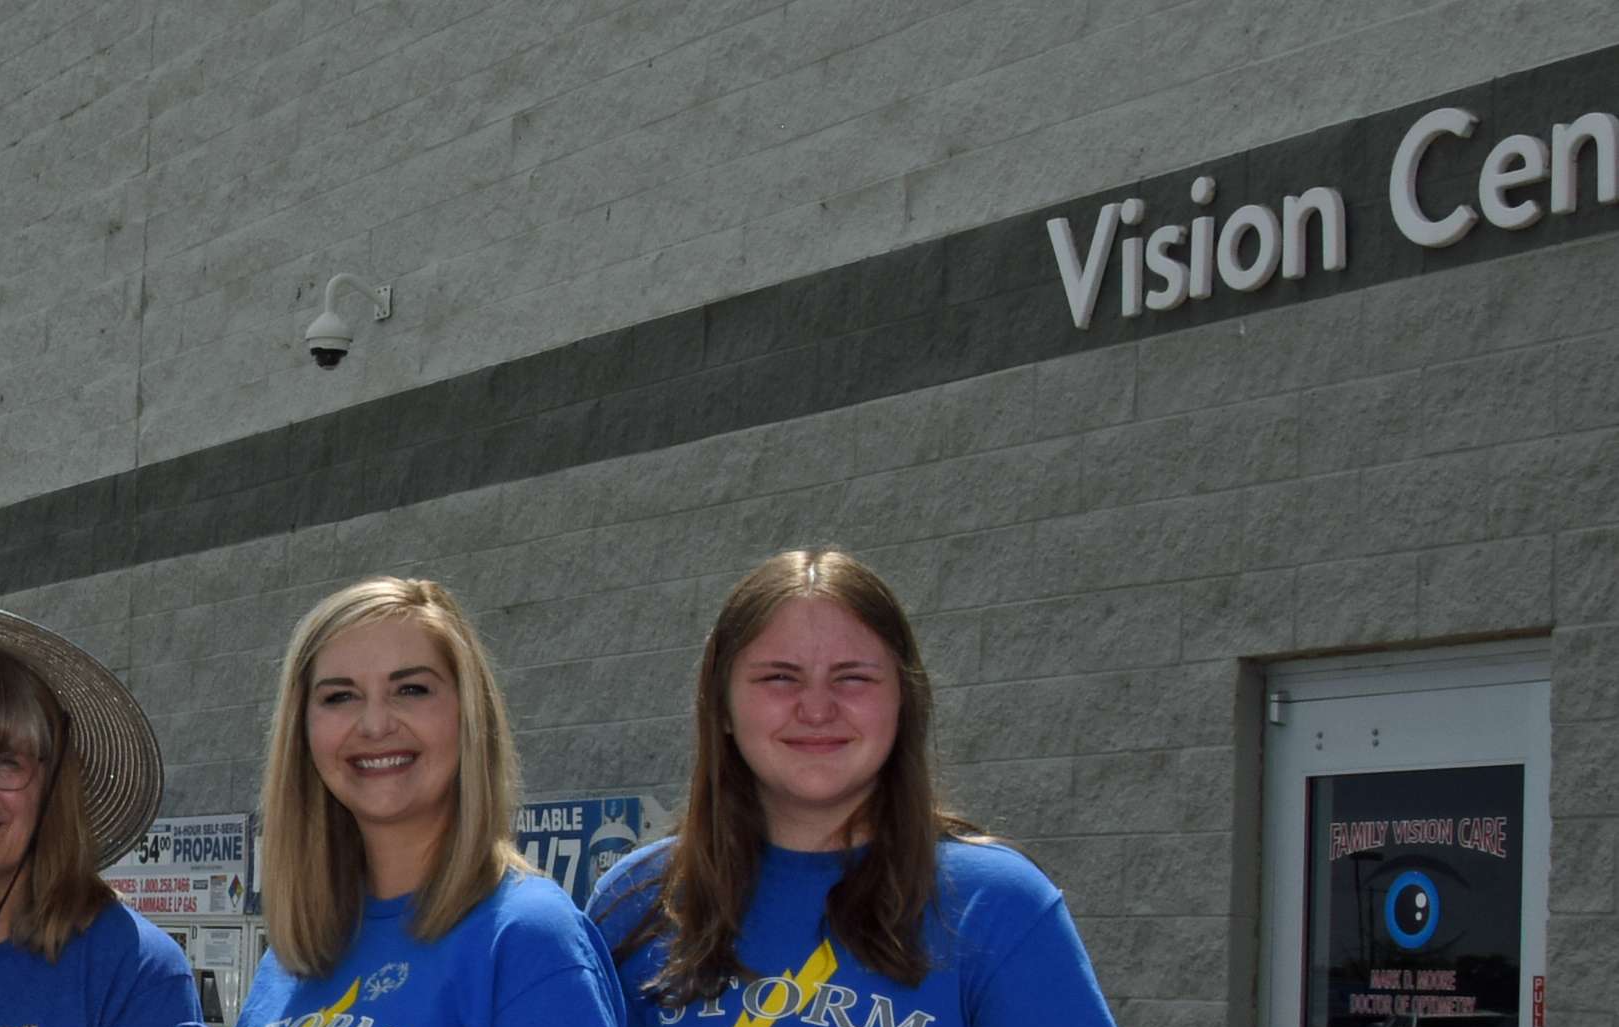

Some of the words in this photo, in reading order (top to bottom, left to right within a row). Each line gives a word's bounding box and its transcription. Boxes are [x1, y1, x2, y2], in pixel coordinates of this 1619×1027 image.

[1047, 176, 1346, 330] Vision
[1389, 107, 1619, 248] Cen
[173, 836, 242, 862] PROPANE
[1330, 820, 1389, 860] FAMILY
[1393, 818, 1453, 845] VISION
[1457, 816, 1507, 858] CARE
